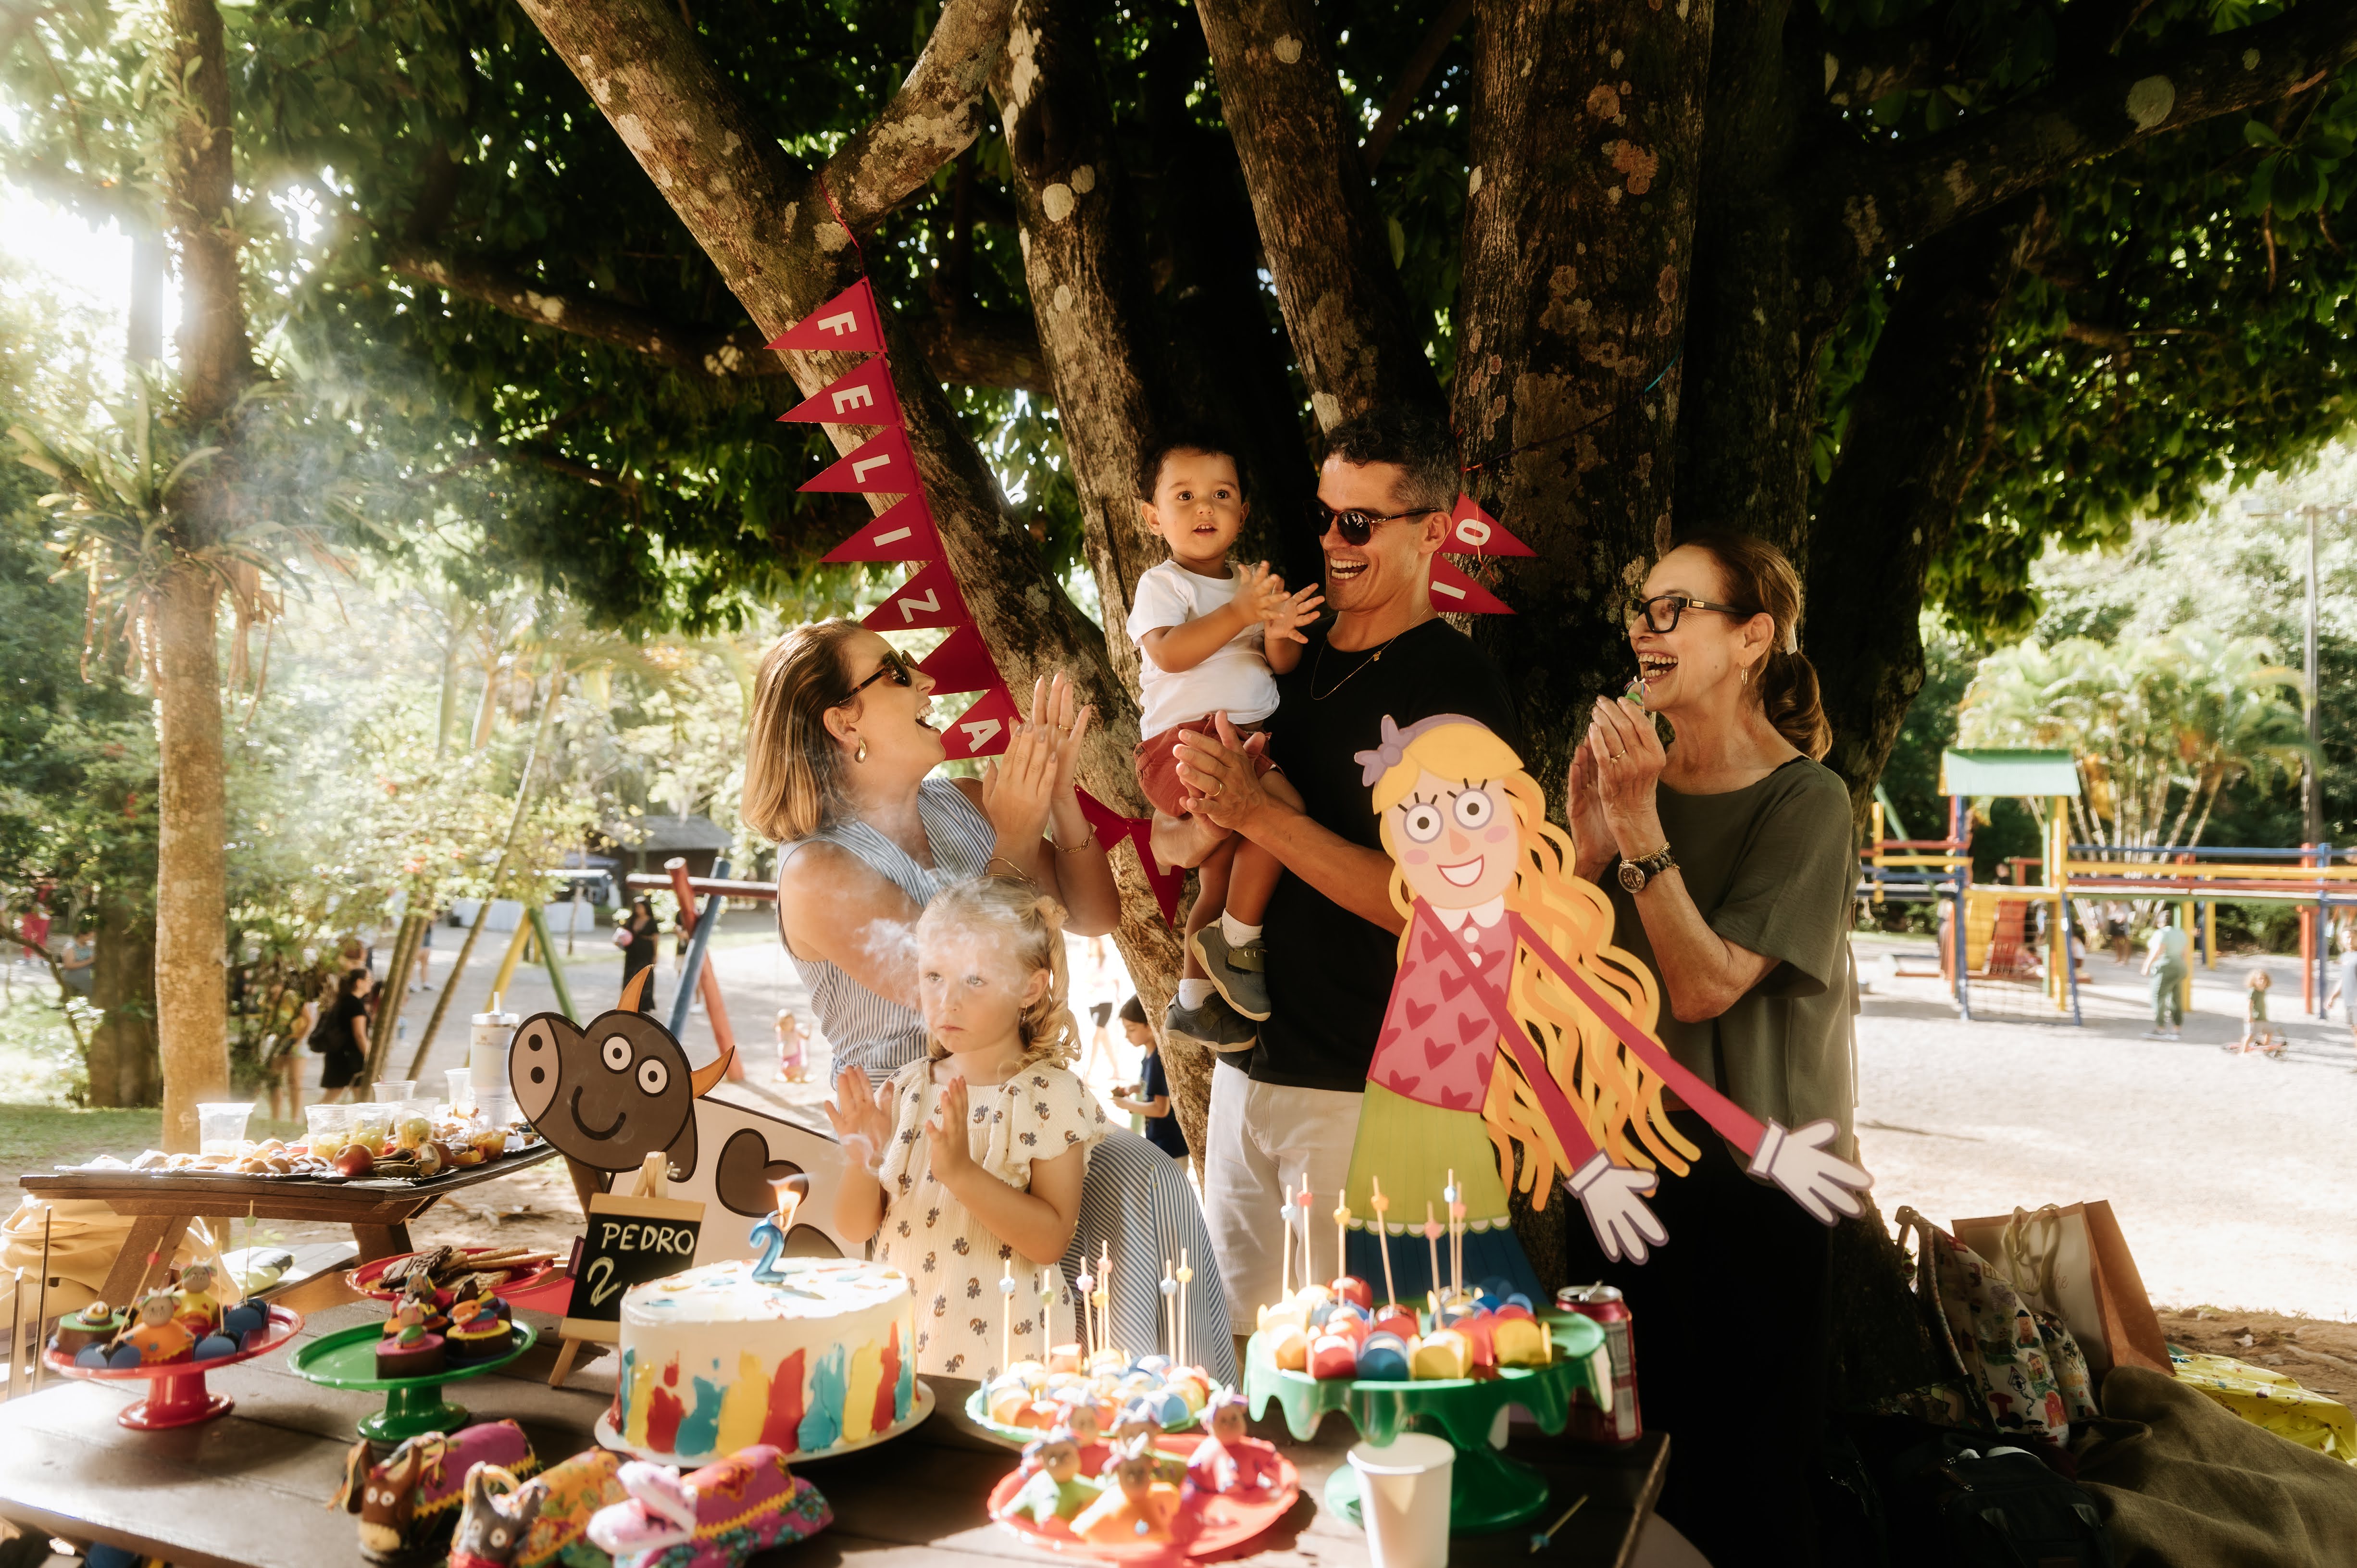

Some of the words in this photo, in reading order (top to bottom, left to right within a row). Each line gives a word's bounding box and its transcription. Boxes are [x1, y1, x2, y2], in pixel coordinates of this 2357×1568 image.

[817, 311, 941, 623] FELIZ
[602, 1222, 695, 1255] PEDRO
[749, 1220, 786, 1283] 2
[587, 1257, 621, 1307] 2
